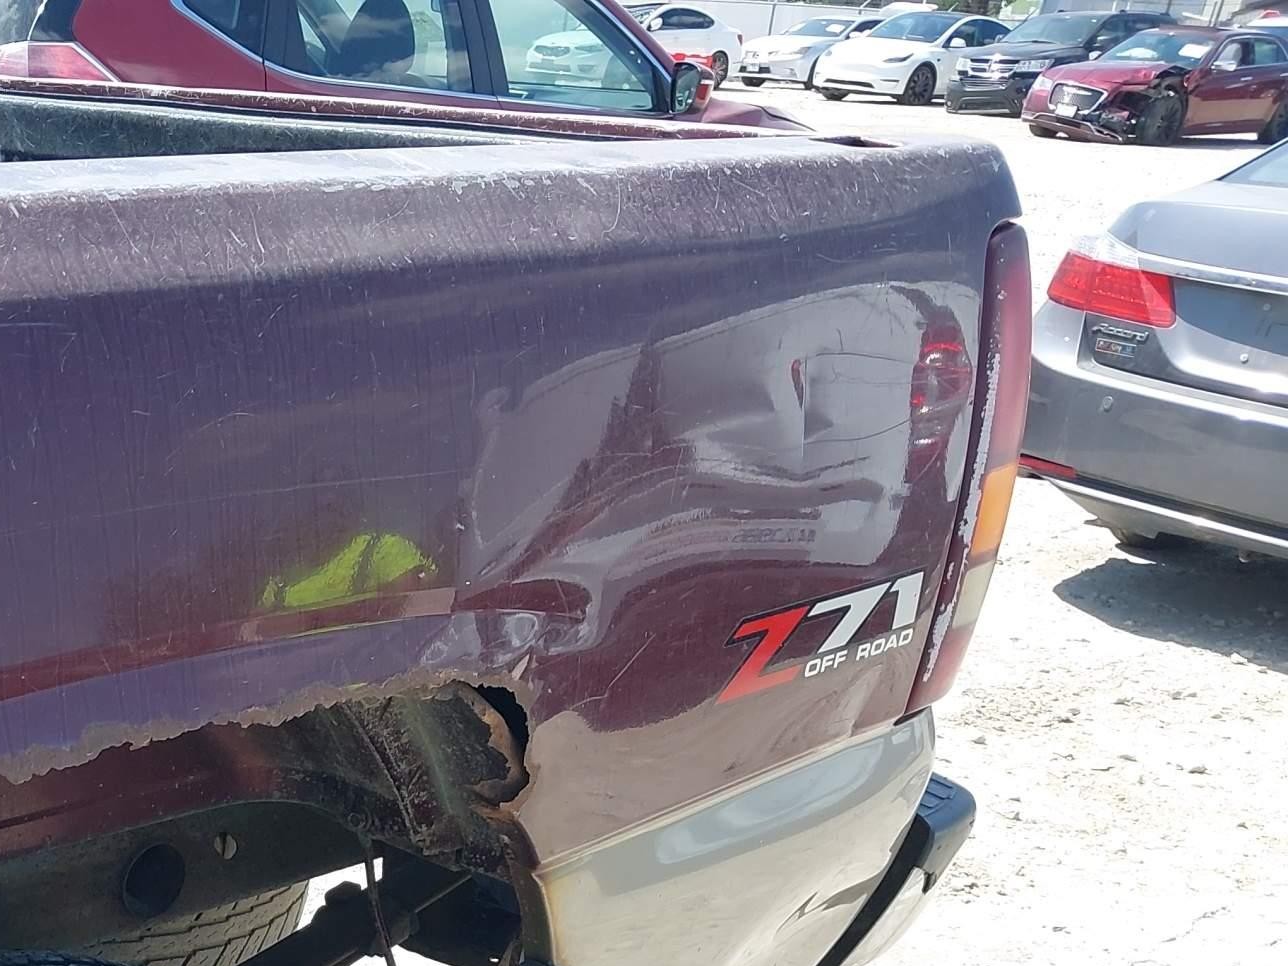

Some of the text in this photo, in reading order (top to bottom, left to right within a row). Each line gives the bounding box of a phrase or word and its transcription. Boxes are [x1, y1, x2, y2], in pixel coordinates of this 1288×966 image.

[1091, 323, 1150, 343] Accord
[716, 571, 925, 705] Z71
[804, 627, 914, 678] OFF ROAD
